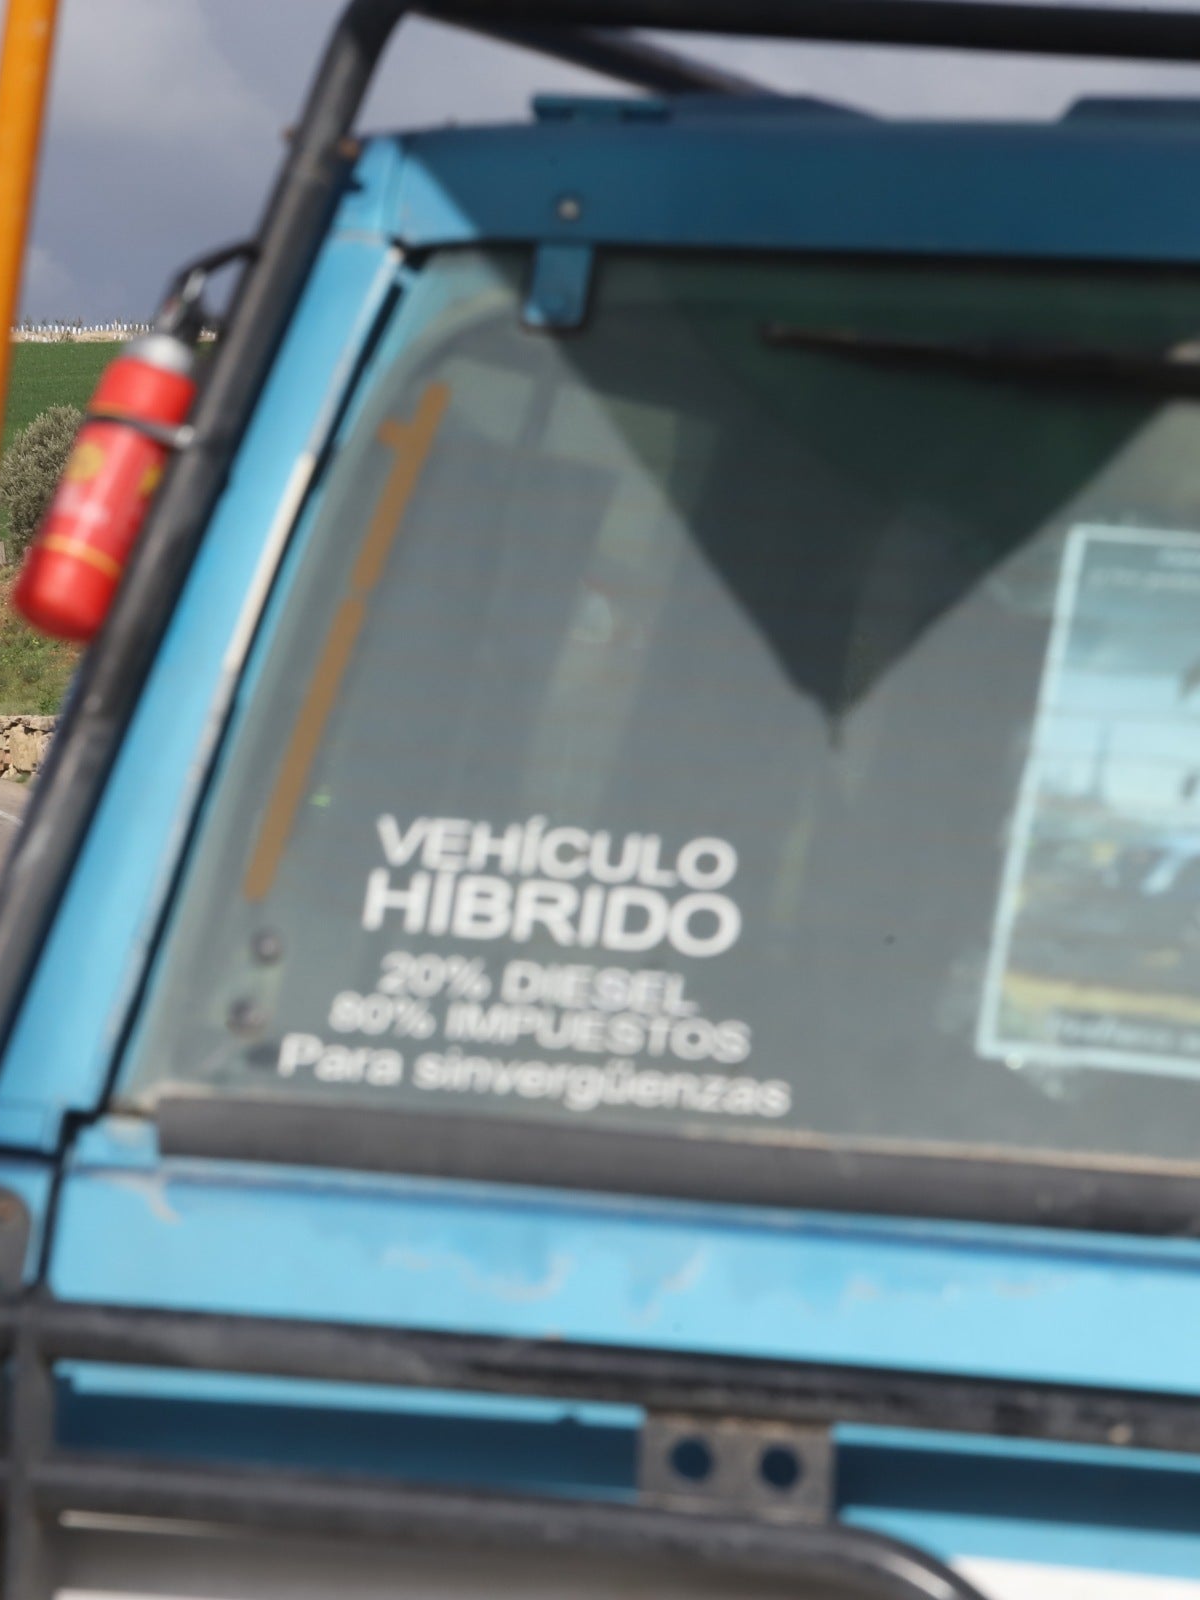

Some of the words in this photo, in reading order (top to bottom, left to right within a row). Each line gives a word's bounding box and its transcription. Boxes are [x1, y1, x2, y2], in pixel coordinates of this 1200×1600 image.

[377, 813, 738, 891] VEHÍCULO
[377, 950, 492, 1001] 20%
[501, 960, 701, 1018] DIESEL
[444, 1001, 752, 1064] IMPUESTOS
[278, 1032, 404, 1087] Para
[412, 1045, 792, 1118] sinvergüenzas
